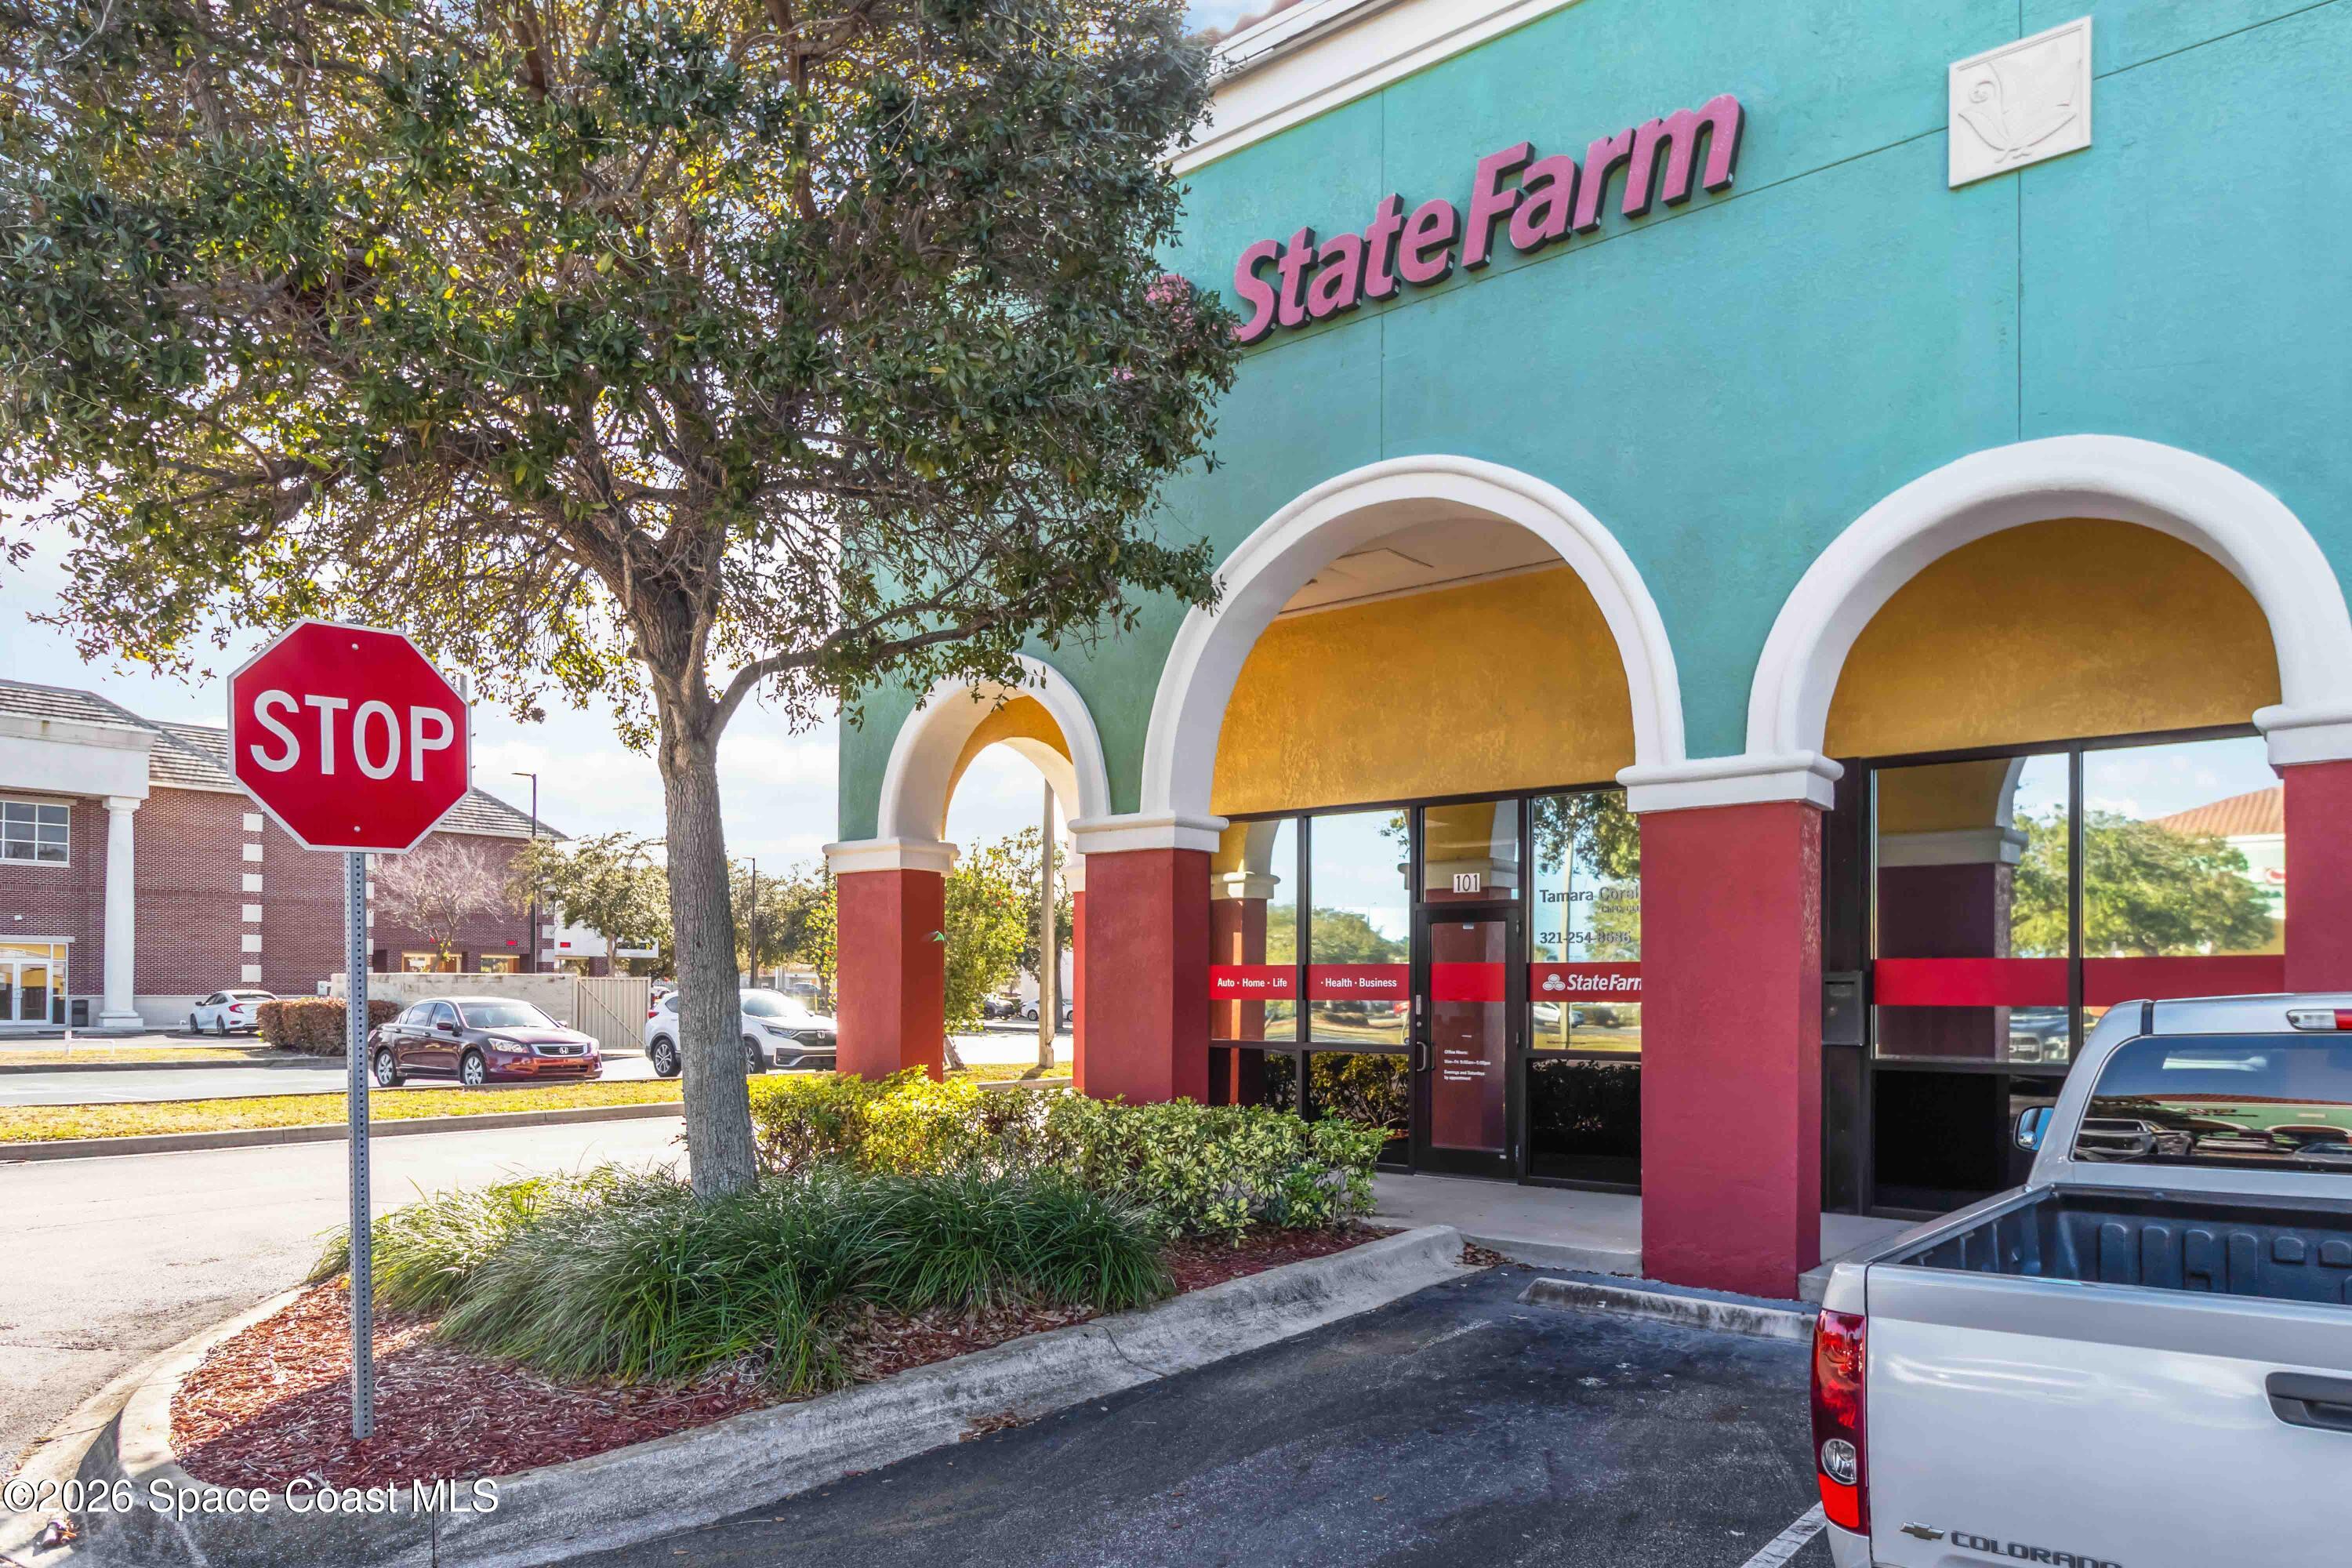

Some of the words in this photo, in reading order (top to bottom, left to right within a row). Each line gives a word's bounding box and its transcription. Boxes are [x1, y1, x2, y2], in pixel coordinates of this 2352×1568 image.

[250, 689, 454, 782] STOP
[1456, 874, 1478, 891] 101
[1539, 889, 1594, 902] Tamara
[1218, 978, 1235, 987] Auto
[1242, 978, 1265, 987] Home
[1272, 978, 1287, 987] Life
[1325, 978, 1352, 988] Health
[1359, 978, 1397, 988] Business
